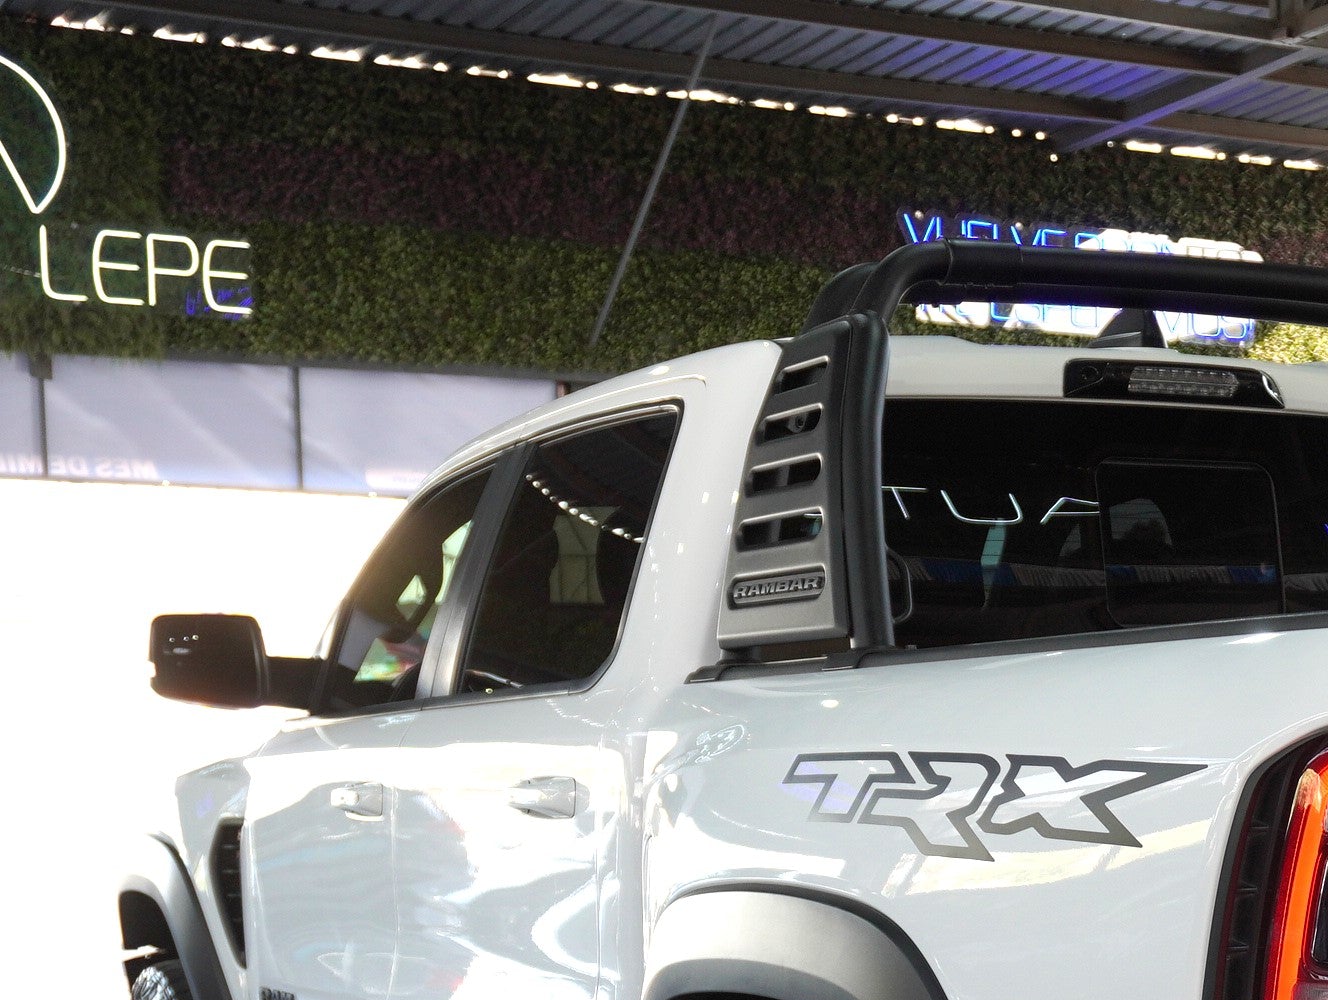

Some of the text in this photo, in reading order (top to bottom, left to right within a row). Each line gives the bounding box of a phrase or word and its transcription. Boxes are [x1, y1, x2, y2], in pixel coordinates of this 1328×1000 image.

[40, 224, 253, 314] LEPE
[733, 576, 820, 599] RAMBAR
[782, 751, 1208, 861] TRX
